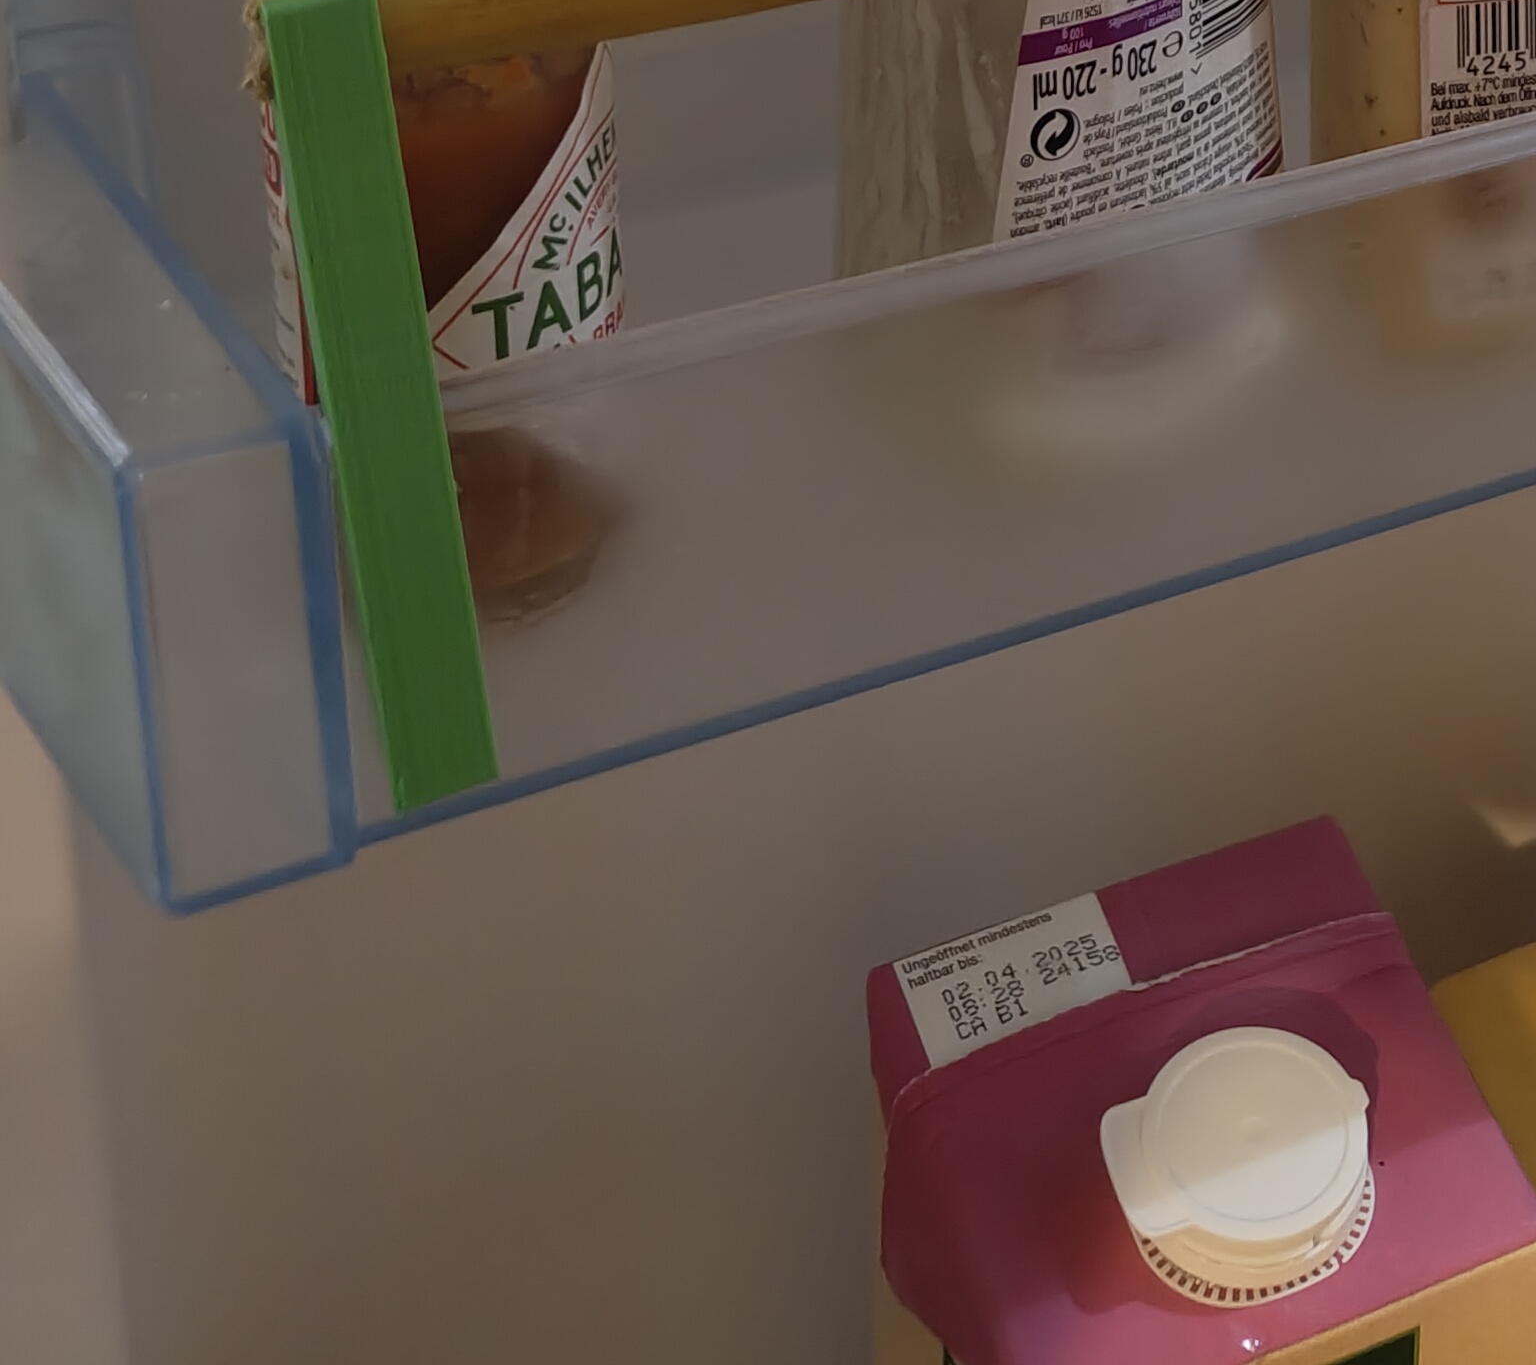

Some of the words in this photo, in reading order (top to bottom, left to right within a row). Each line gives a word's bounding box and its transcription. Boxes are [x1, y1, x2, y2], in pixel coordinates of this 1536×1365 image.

[1057, 11, 1070, 25] 371
[1070, 27, 1084, 39] 100
[1112, 44, 1123, 78] g
[1128, 39, 1157, 81] 230
[1466, 51, 1527, 76] 4245
[1033, 70, 1057, 110] ml
[1064, 59, 1097, 100] 220
[1431, 81, 1446, 96] Bei
[1474, 92, 1496, 107] Nach
[1498, 91, 1517, 104] dem
[1431, 112, 1450, 127] und
[1453, 108, 1490, 125] alsbald
[901, 939, 976, 975] Ungeöffnet
[977, 912, 1053, 947] mindestens
[907, 962, 955, 990] haltbar
[957, 952, 985, 970] bis:
[1041, 945, 1121, 986] 24158
[955, 1017, 988, 1040] CA
[996, 998, 1028, 1025] B1
